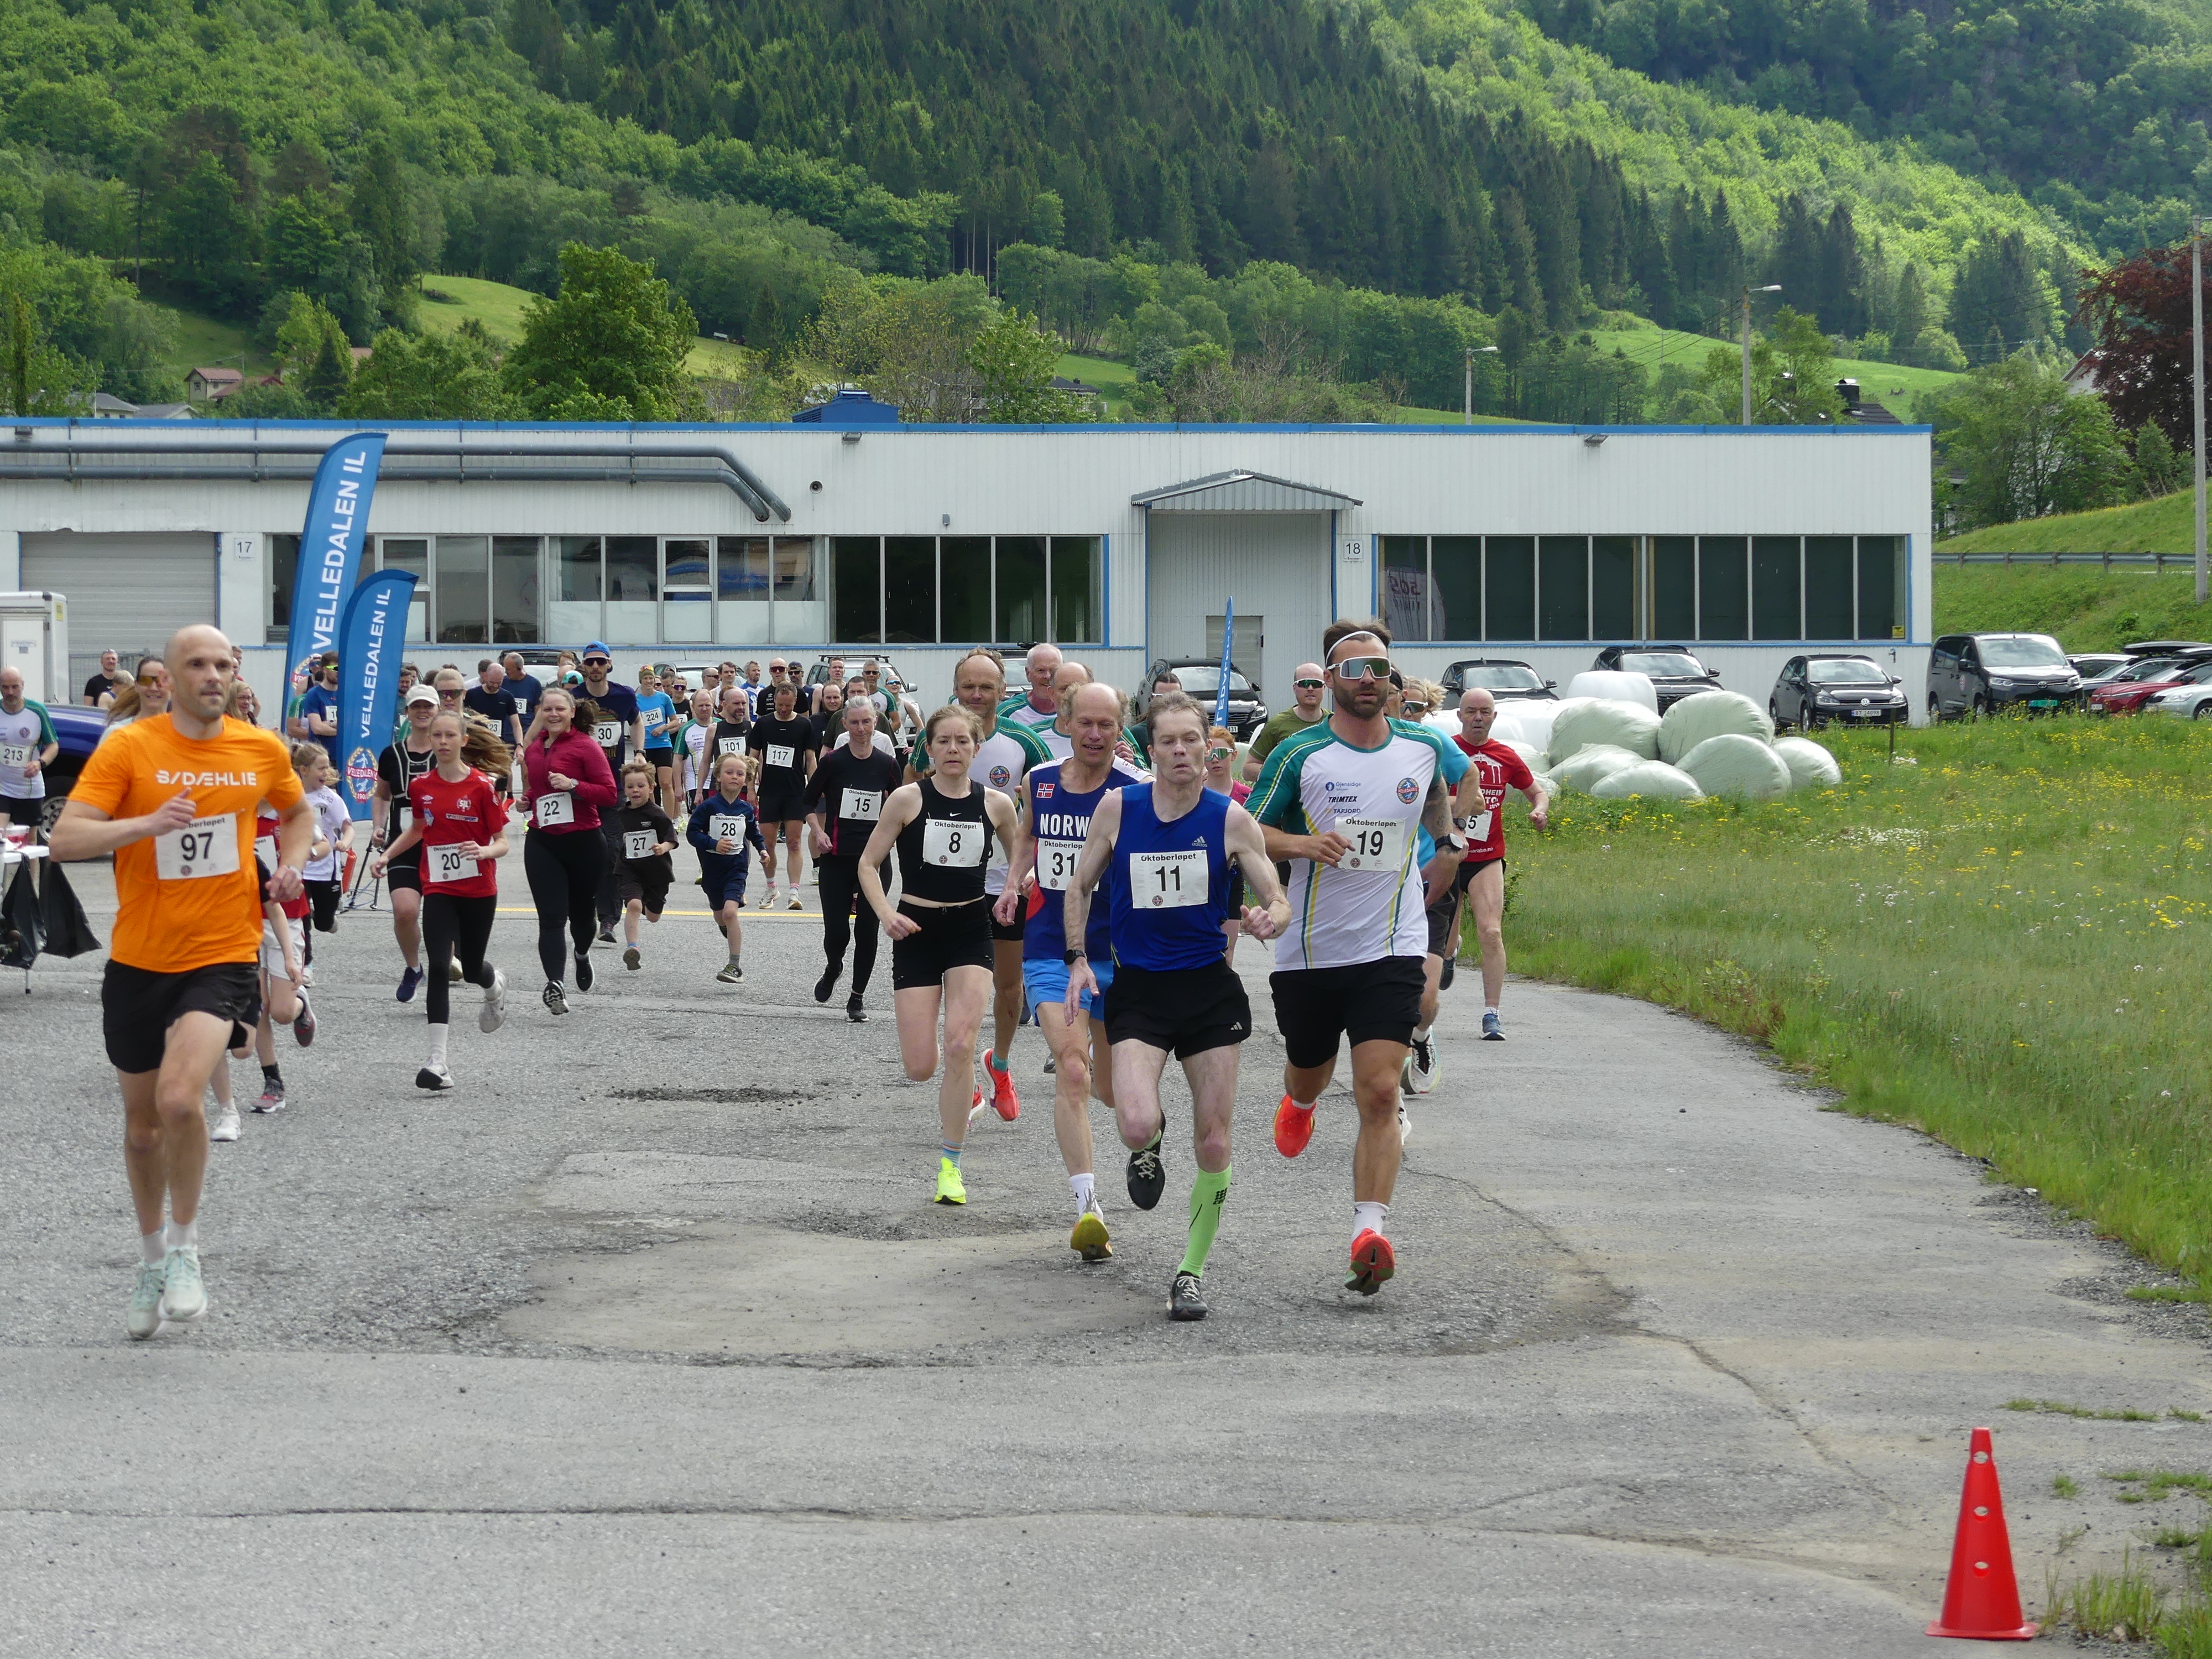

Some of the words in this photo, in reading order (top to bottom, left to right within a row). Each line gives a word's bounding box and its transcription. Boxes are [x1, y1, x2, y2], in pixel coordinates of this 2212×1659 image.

[237, 541, 252, 553] 17
[312, 479, 359, 650] VELLEDALEN
[343, 451, 367, 474] IL
[1345, 542, 1360, 554] 18
[361, 610, 386, 738] VELLEDALEN
[376, 588, 391, 605] IL
[646, 712, 659, 722] 224
[598, 728, 612, 740] 30
[724, 742, 740, 752] 101
[4, 748, 23, 761] 213
[773, 750, 789, 761] 117
[544, 800, 560, 817] 22
[854, 797, 871, 812] 15
[187, 817, 226, 829] berløpet
[721, 822, 737, 837] 28
[935, 821, 977, 831] Oktoberløpet
[1040, 813, 1090, 837] NORW
[1346, 818, 1397, 828] Oktoberløpet
[181, 831, 214, 861] 97
[633, 837, 646, 851] 27
[948, 832, 961, 854] 8
[1045, 840, 1083, 850] Oktoberløp
[1357, 830, 1384, 856] 19
[441, 852, 461, 871] 20
[1052, 851, 1076, 877] 31
[1141, 852, 1196, 862] Oktoberløpet
[1155, 865, 1181, 891] 11
